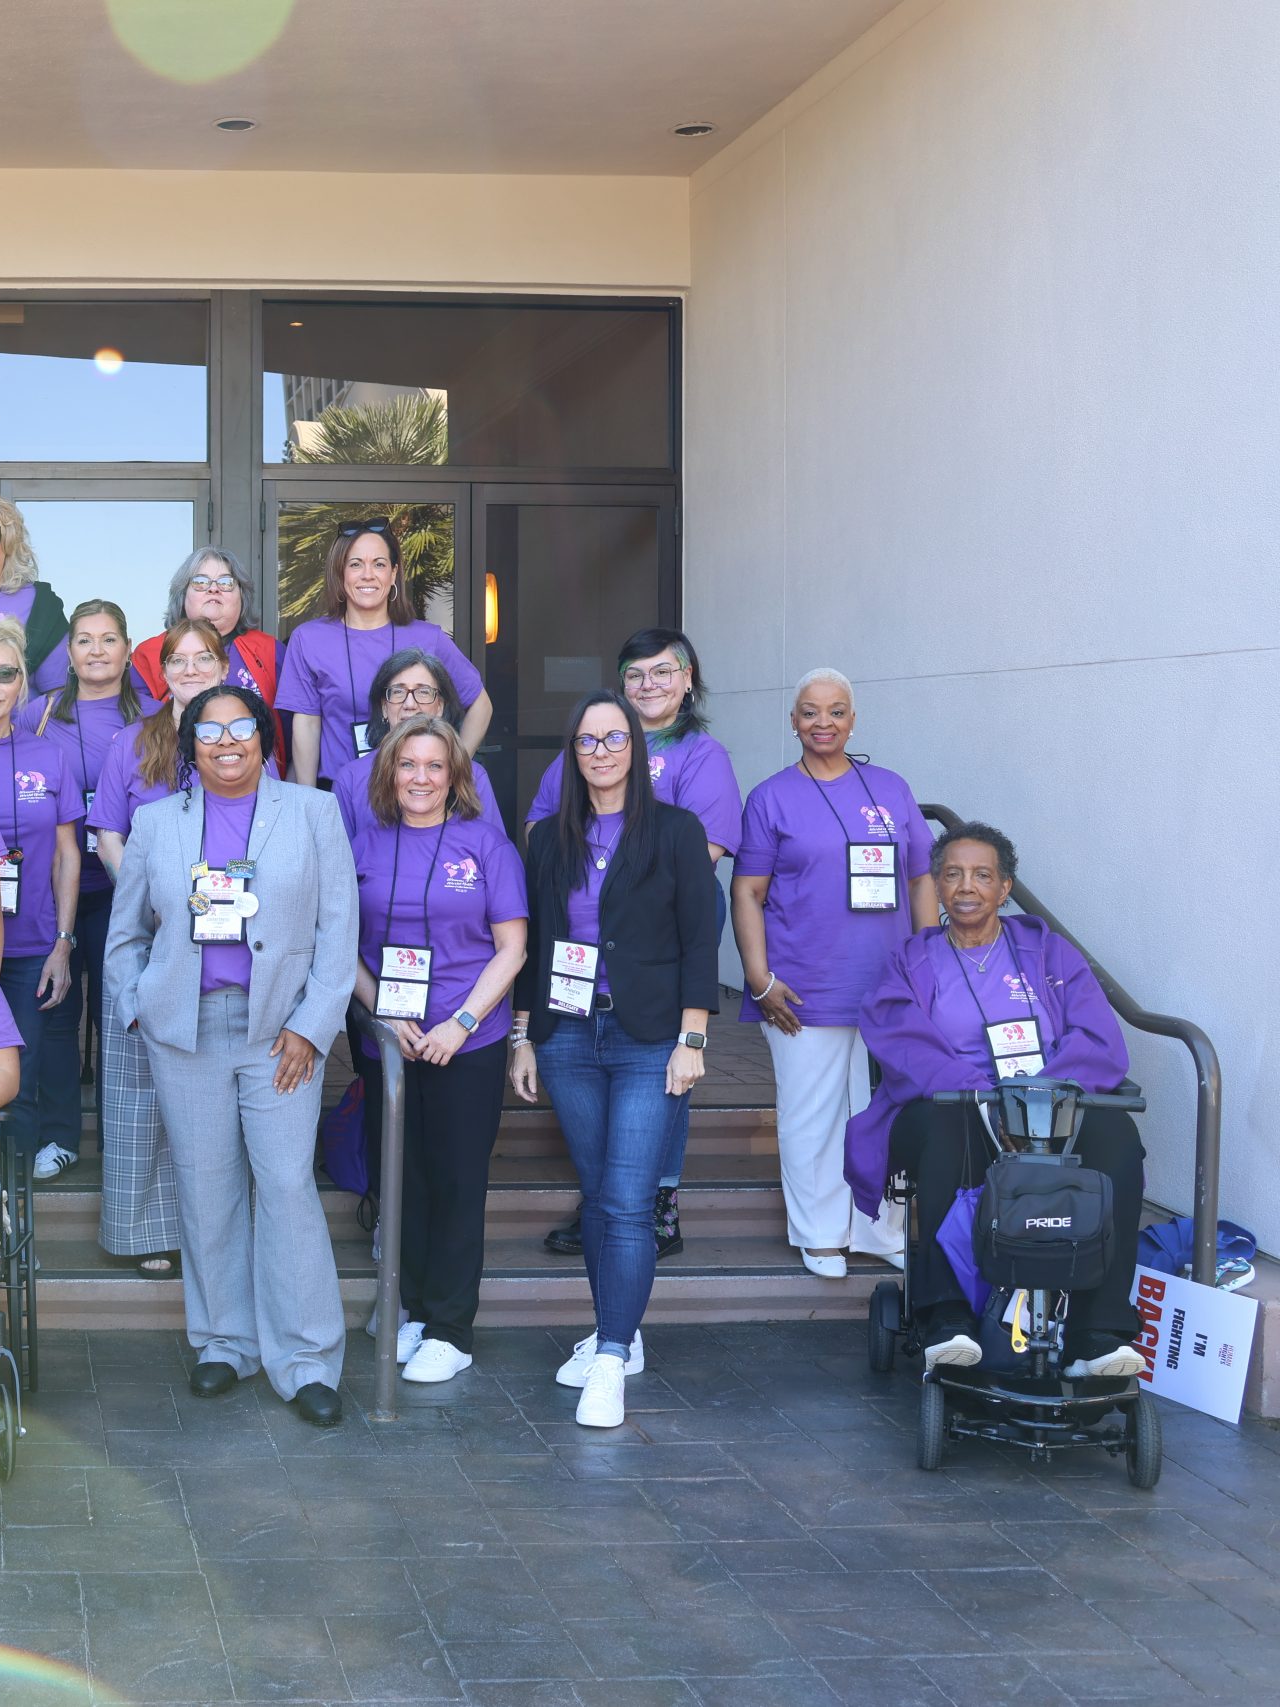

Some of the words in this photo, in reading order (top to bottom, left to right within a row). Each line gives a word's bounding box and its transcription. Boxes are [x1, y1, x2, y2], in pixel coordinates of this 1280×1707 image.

[1025, 1217, 1072, 1229] PRIDE
[1166, 1308, 1186, 1370] FIGHTING
[1193, 1332, 1208, 1358] I'M
[1220, 1343, 1228, 1365] RIGHTS
